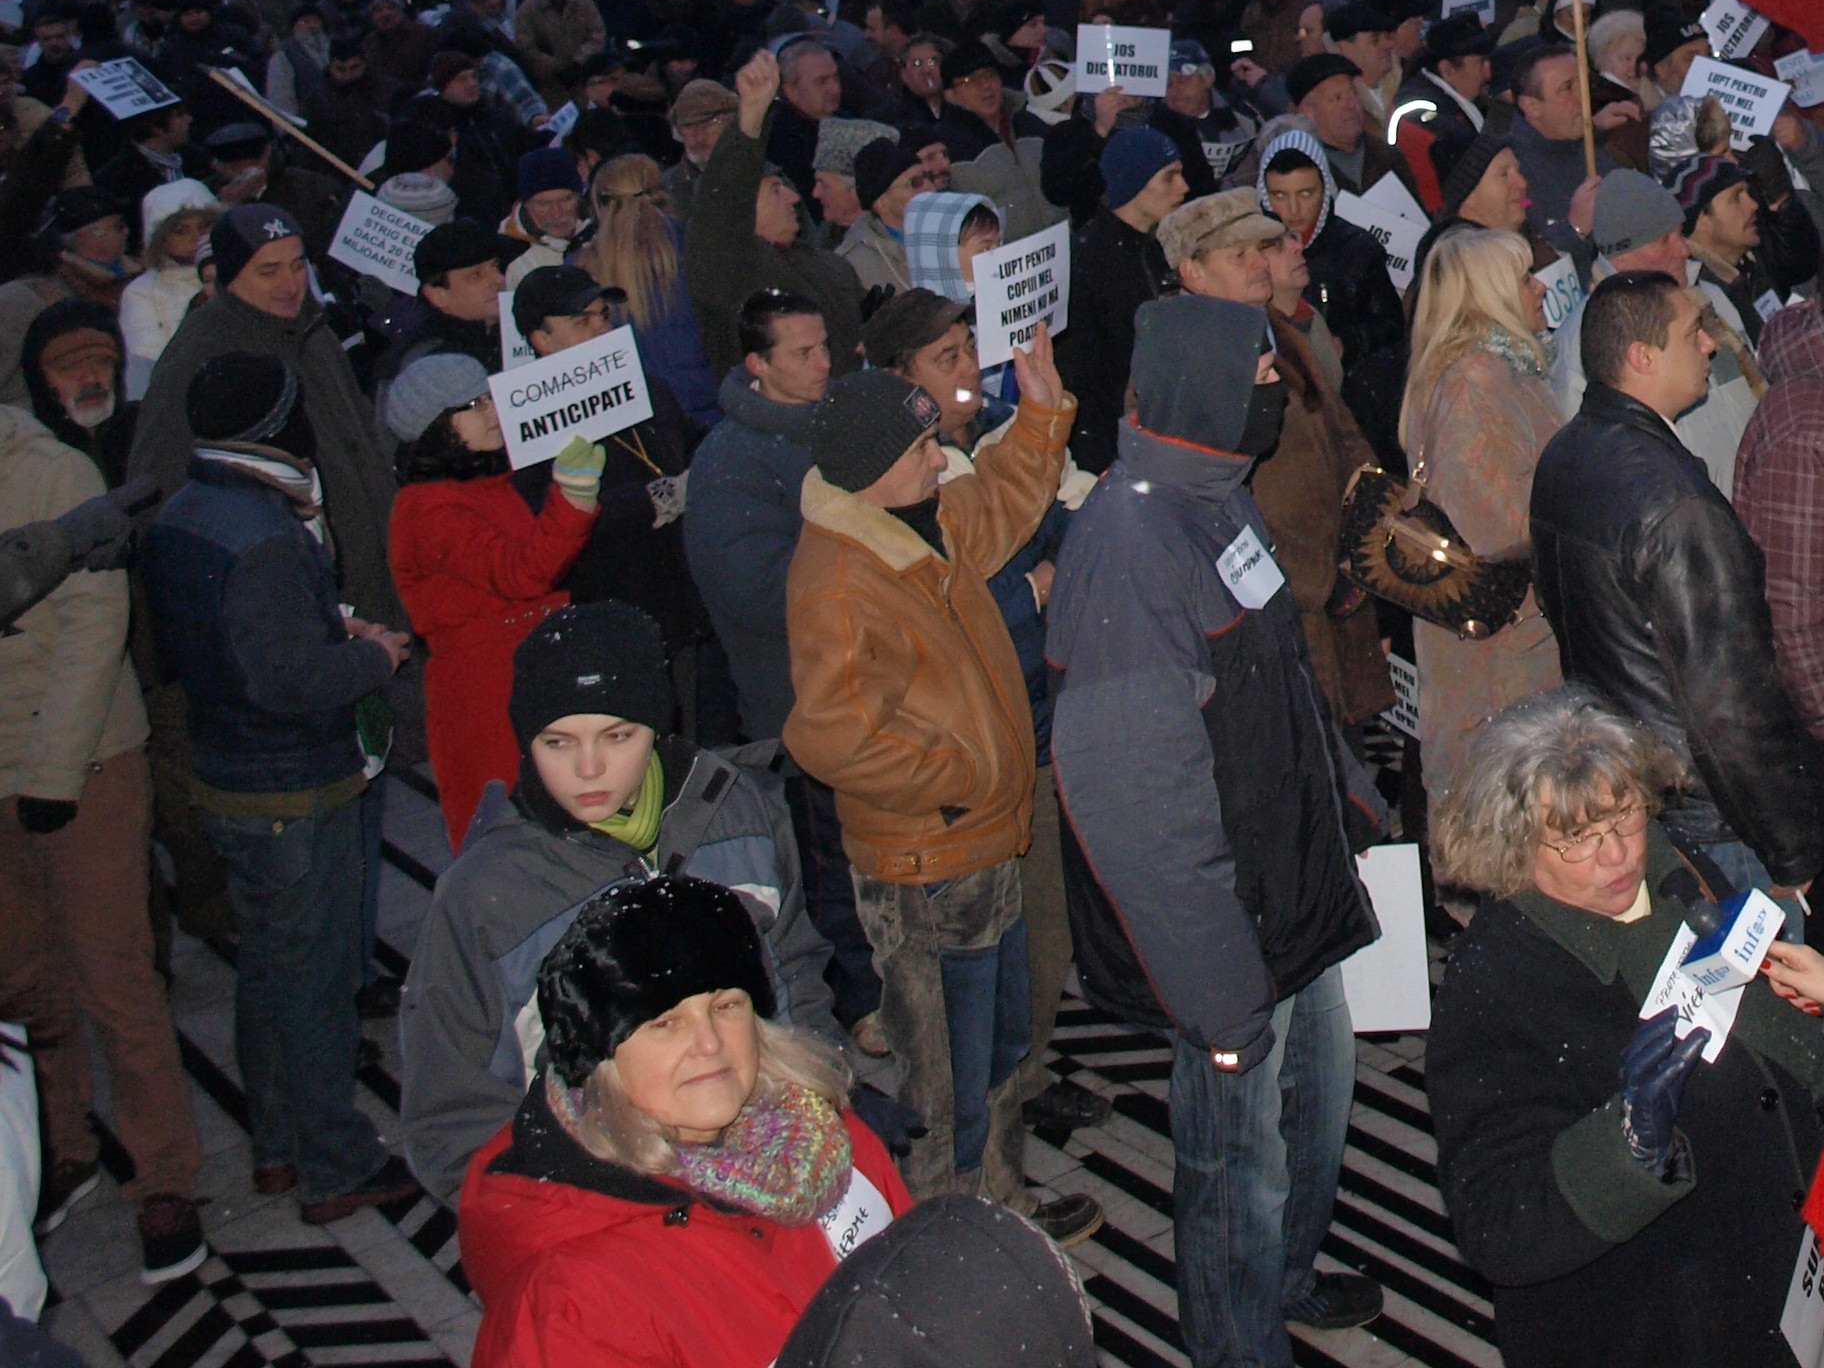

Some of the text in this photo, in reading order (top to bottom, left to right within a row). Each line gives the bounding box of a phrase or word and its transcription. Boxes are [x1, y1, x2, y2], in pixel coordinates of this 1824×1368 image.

[1114, 43, 1136, 58] JOS
[1086, 61, 1159, 79] DICATORUL
[364, 217, 401, 241] STRIG
[342, 236, 398, 270] MILIOANE
[998, 243, 1057, 280] LUPT PENTRU
[1007, 275, 1037, 301] COPIII
[1001, 299, 1037, 328] NIMENI
[510, 350, 629, 408] COMASATE
[519, 381, 635, 442] ANTICIPATE
